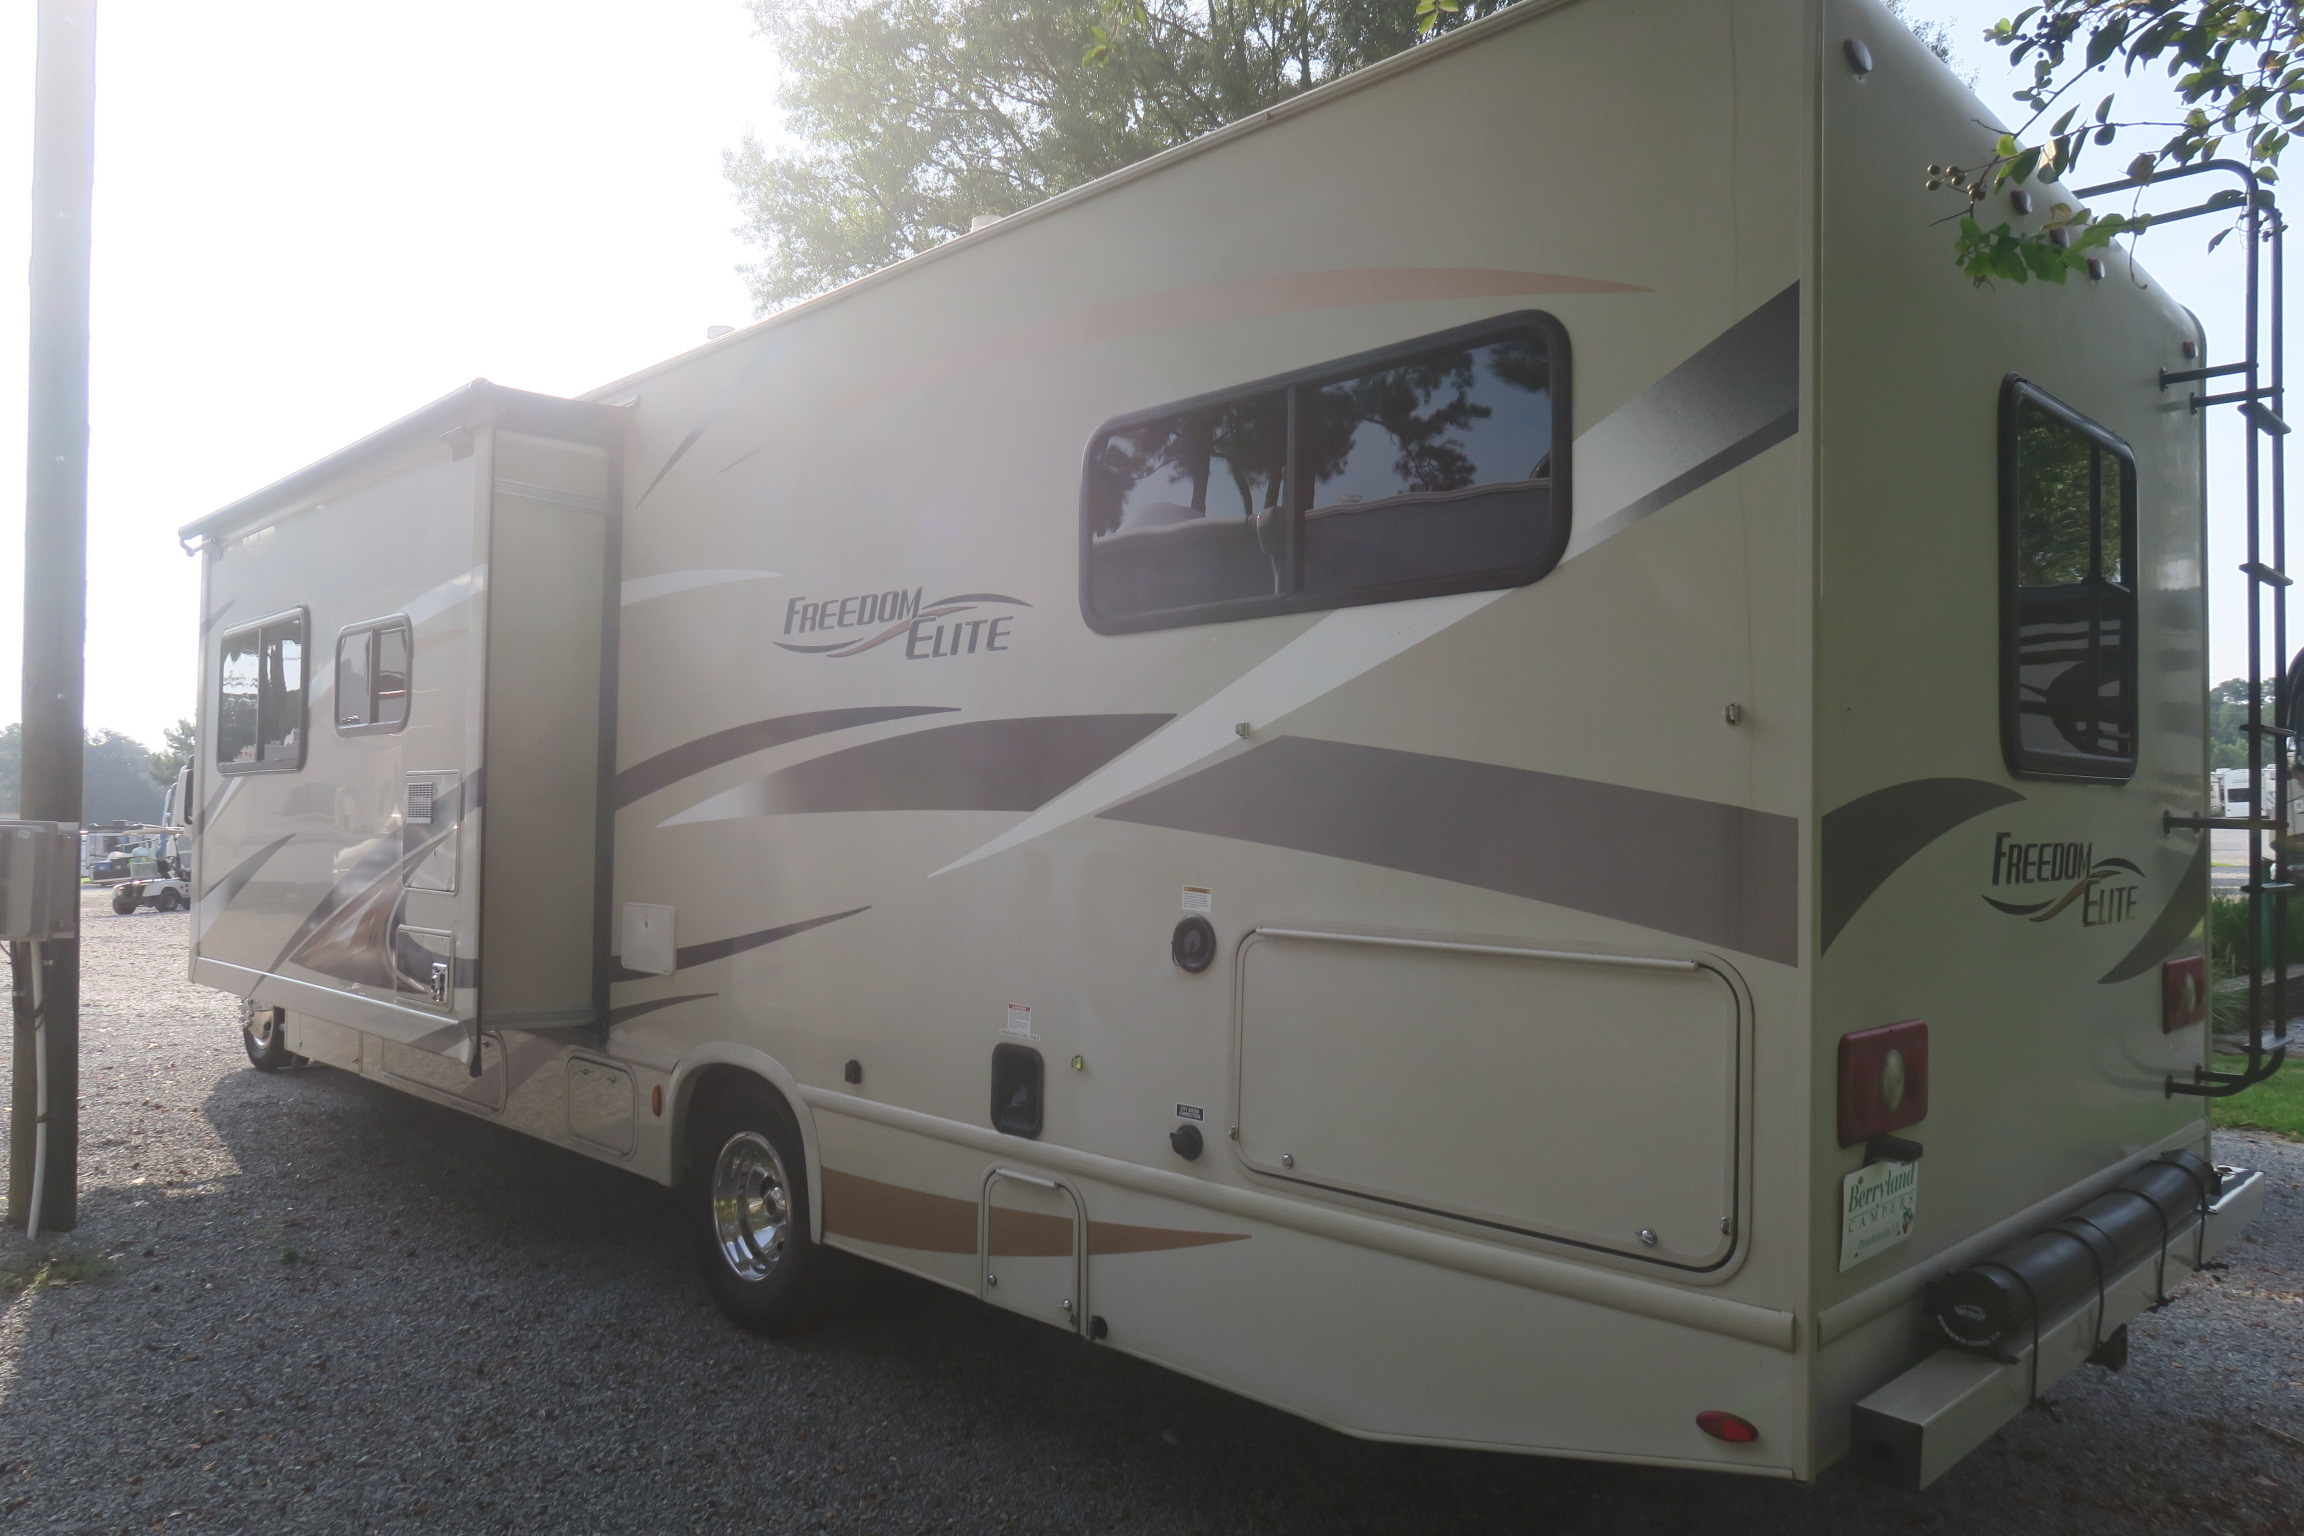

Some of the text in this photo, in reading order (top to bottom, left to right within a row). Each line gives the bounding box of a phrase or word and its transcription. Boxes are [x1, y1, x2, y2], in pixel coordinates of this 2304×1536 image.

[783, 586, 923, 635] FREEDOM
[905, 615, 1014, 660] ELITE
[1992, 832, 2092, 886] FREEDOM
[2081, 878, 2138, 927] ELITE
[1848, 1161, 1915, 1212] Berryland
[1848, 1192, 1914, 1233] CAMPERS
